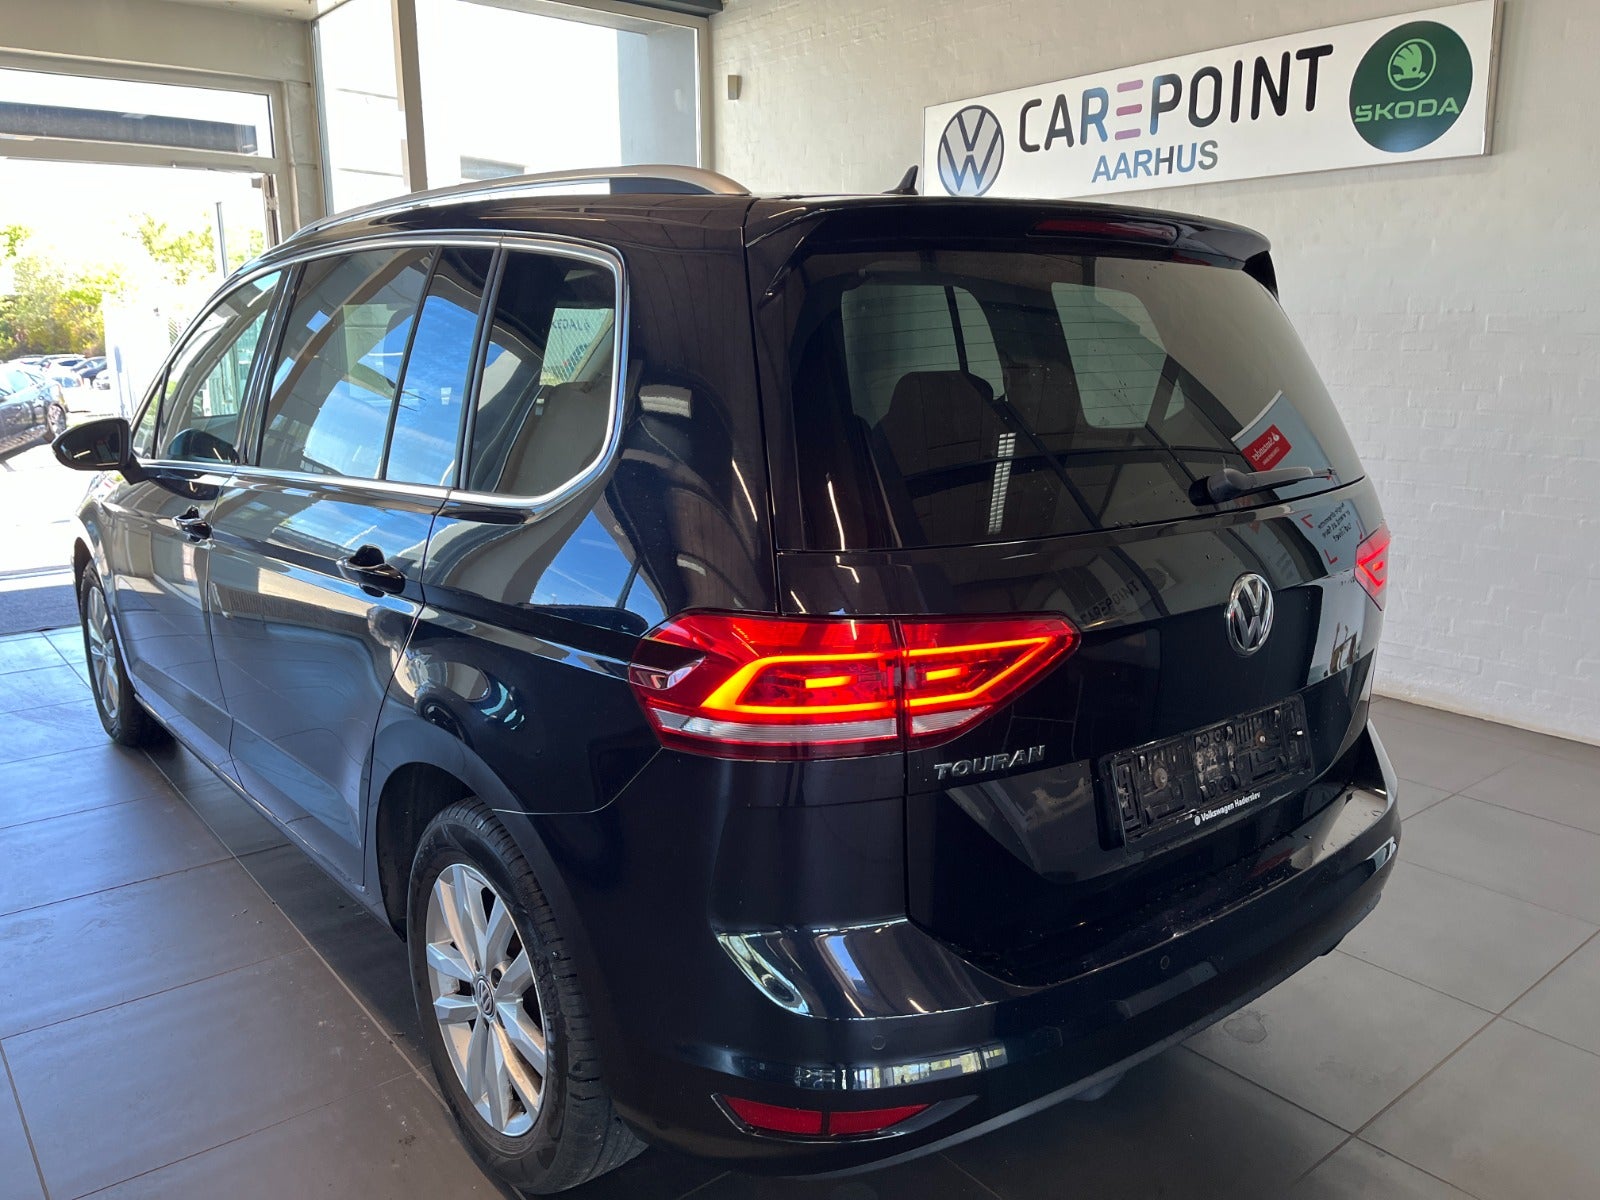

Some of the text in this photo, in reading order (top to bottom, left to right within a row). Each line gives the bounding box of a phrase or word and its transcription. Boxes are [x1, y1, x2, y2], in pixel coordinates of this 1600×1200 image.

[1019, 43, 1334, 153] CAREPOINT
[1091, 140, 1219, 183] AARHUS
[933, 744, 1046, 781] TOURAN
[1201, 792, 1260, 821] Volkswagen Haderslev
